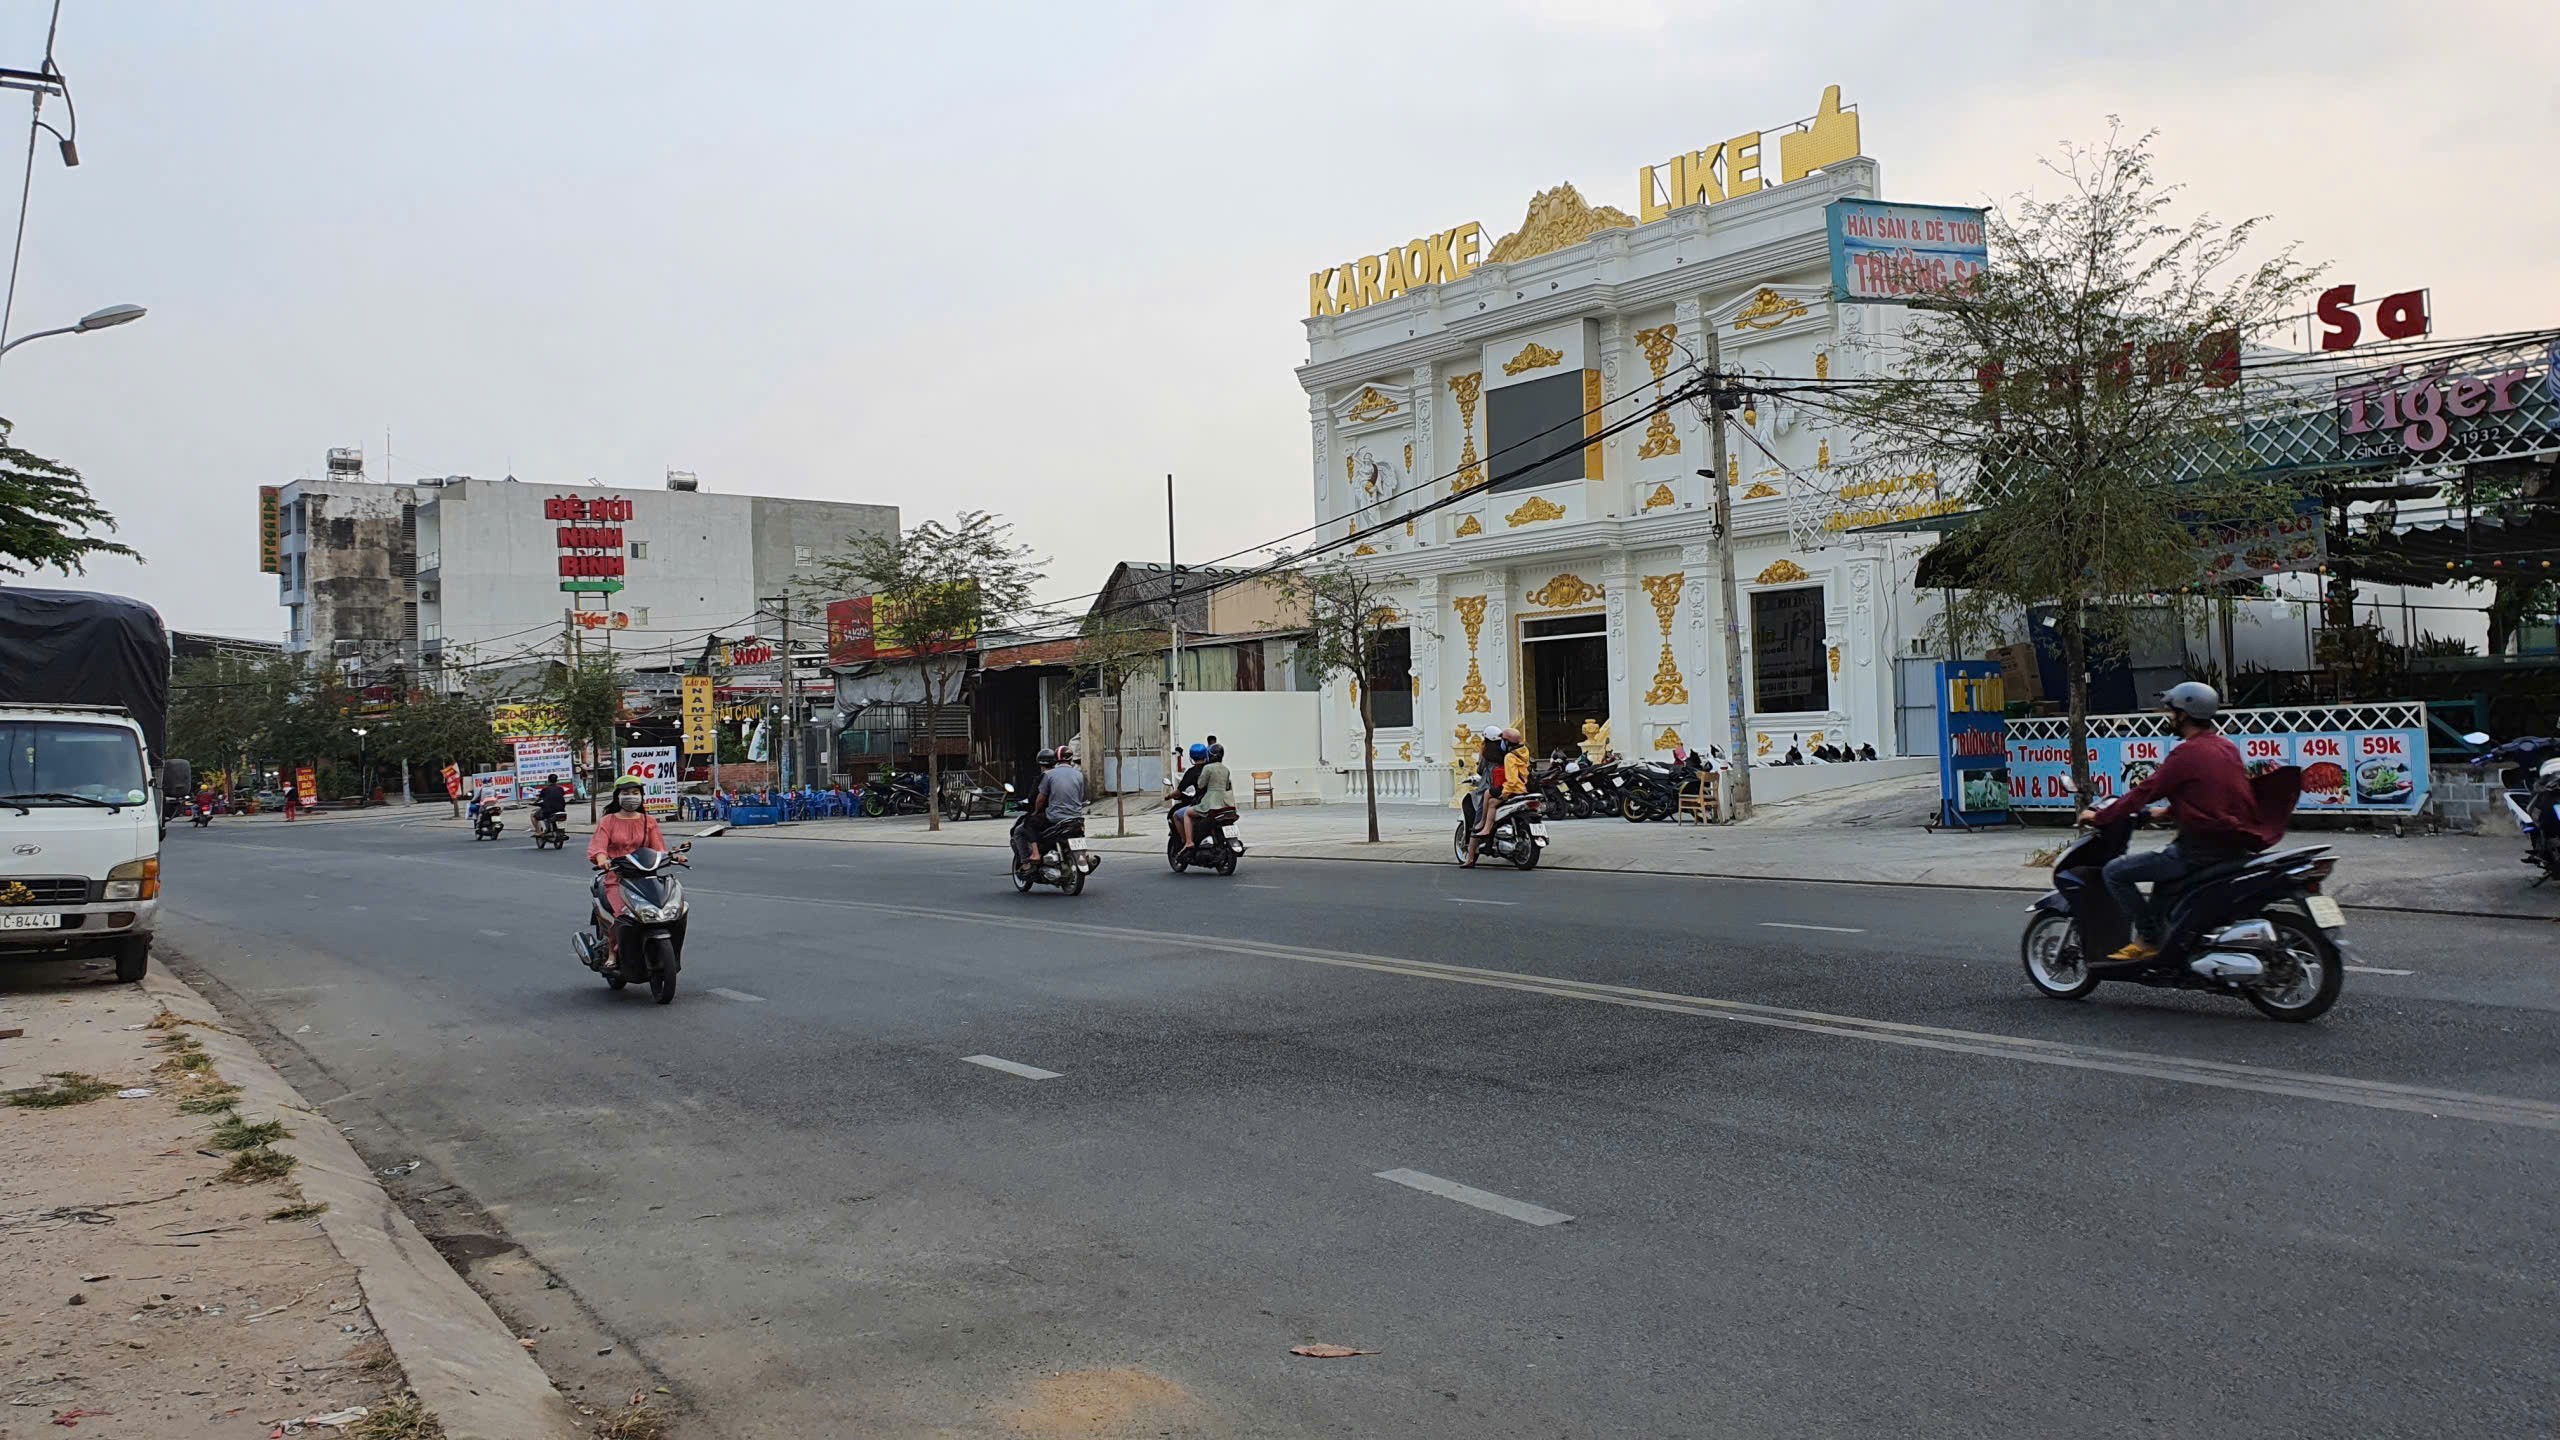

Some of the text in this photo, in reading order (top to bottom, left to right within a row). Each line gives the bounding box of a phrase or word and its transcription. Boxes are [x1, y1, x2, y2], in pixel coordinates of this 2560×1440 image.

[1639, 131, 1761, 224] LIKE
[1847, 208, 1874, 237] HẢI
[1877, 210, 1907, 239] SẢN
[1911, 220, 1922, 241] &
[1926, 216, 1945, 242] DÊ
[1309, 221, 1480, 317] KARAOKE
[1854, 247, 1948, 295] TRƯỜNG
[2336, 359, 2527, 450] Tiger
[2356, 428, 2500, 459] SINCE 1932
[557, 527, 623, 548] NINH
[574, 612, 608, 630] Tiger
[733, 645, 771, 665] SAIGON
[2018, 745, 2072, 764] Trường
[2127, 743, 2158, 759] 19k
[2247, 740, 2281, 757] 39k
[2303, 739, 2340, 756] 49k
[2362, 737, 2401, 754] 59k
[658, 762, 675, 778] 29K
[2031, 778, 2042, 797] &
[0, 914, 56, 928] C-844.41
